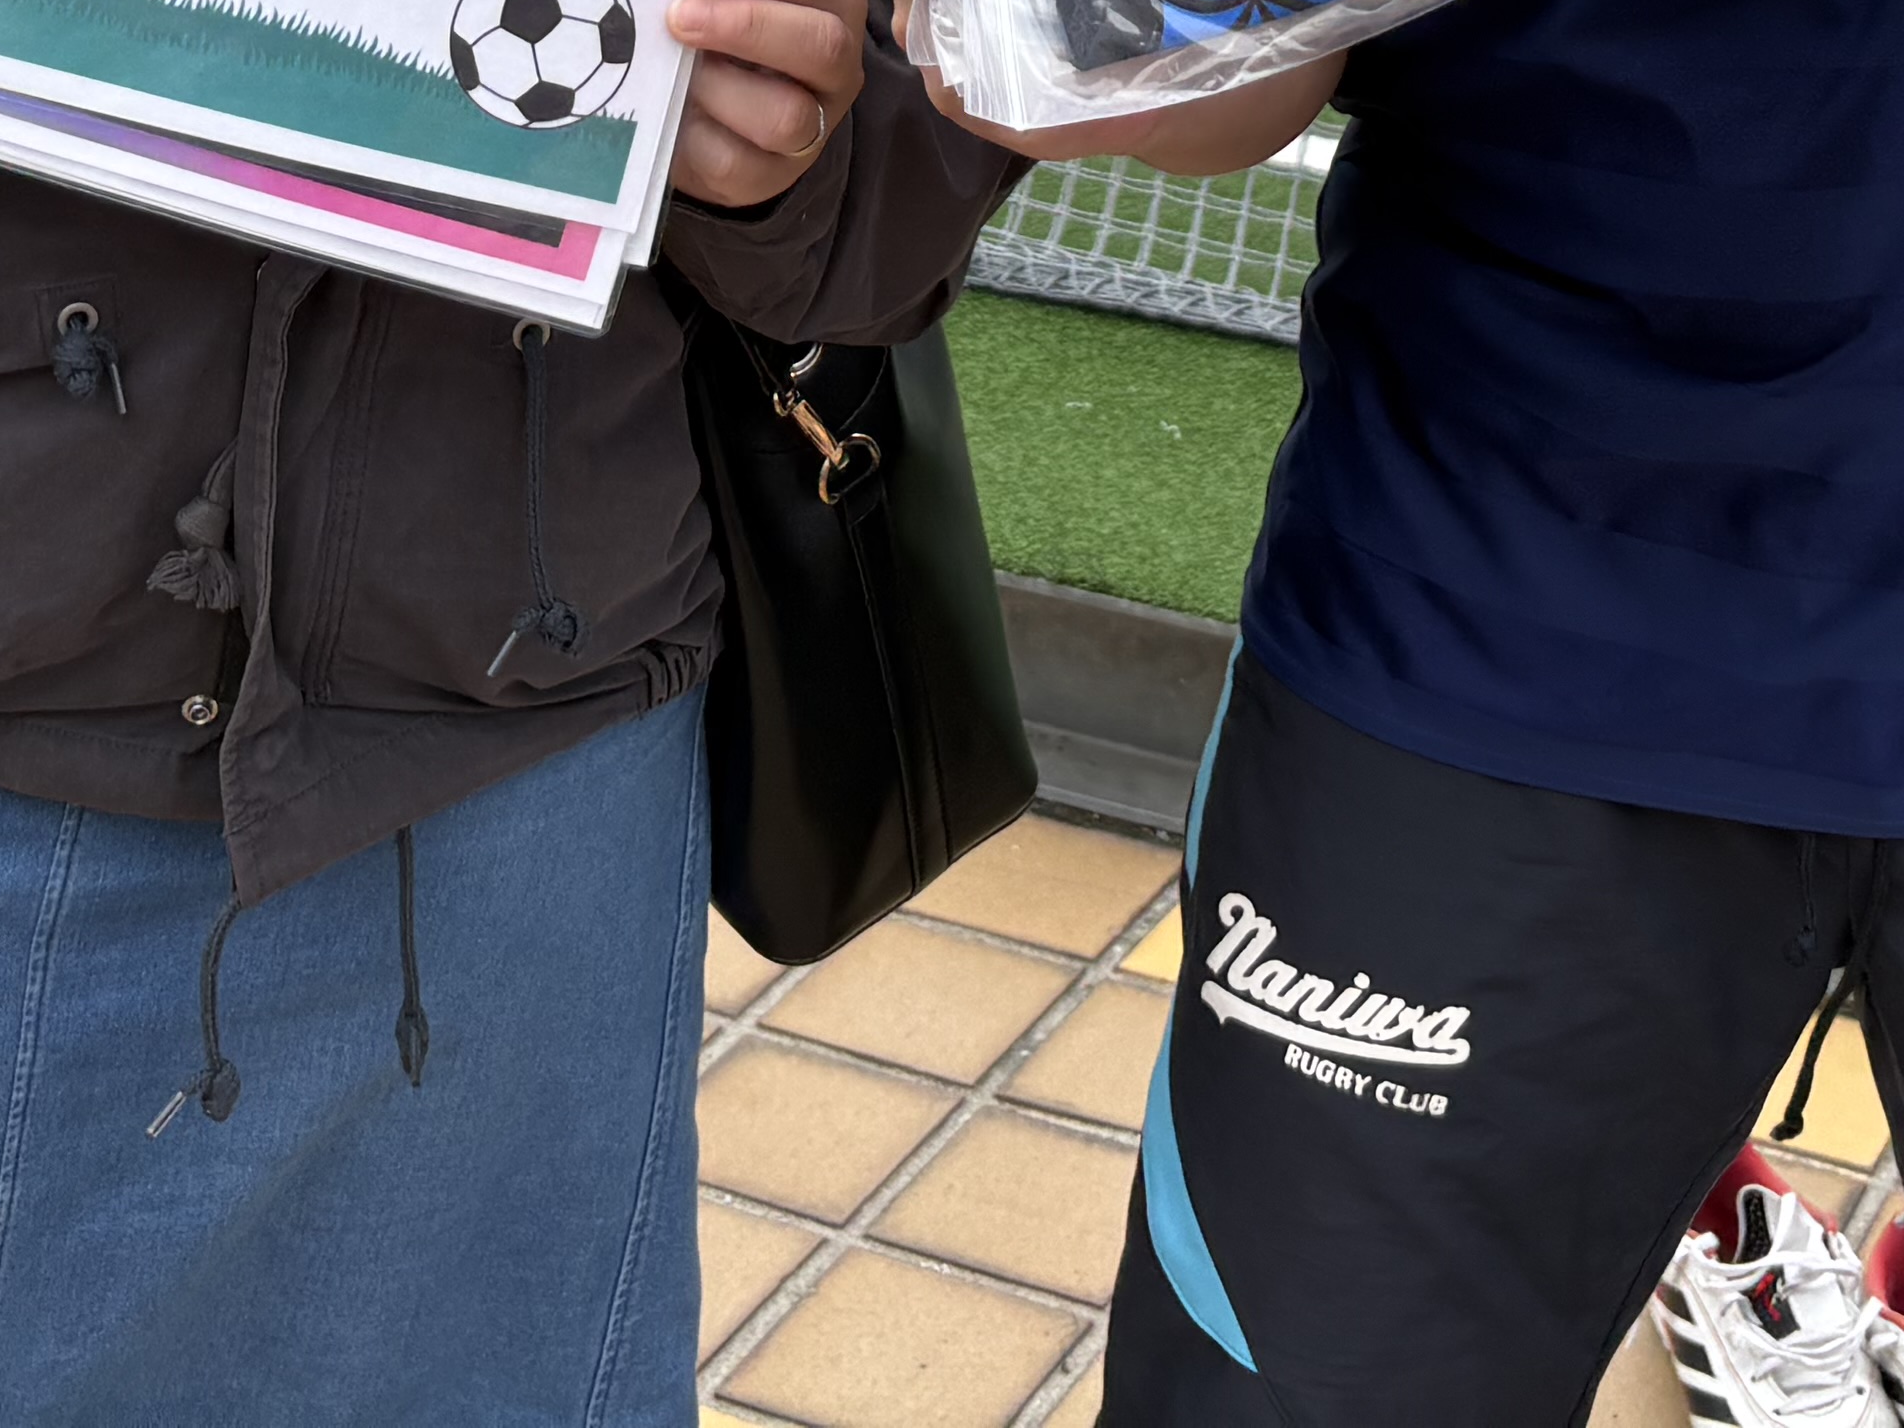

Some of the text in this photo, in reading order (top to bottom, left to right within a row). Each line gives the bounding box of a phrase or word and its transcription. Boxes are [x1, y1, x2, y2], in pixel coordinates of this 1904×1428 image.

[1204, 892, 1472, 1054] Naniwa
[1284, 1043, 1449, 1116] RUGBY CLUB
